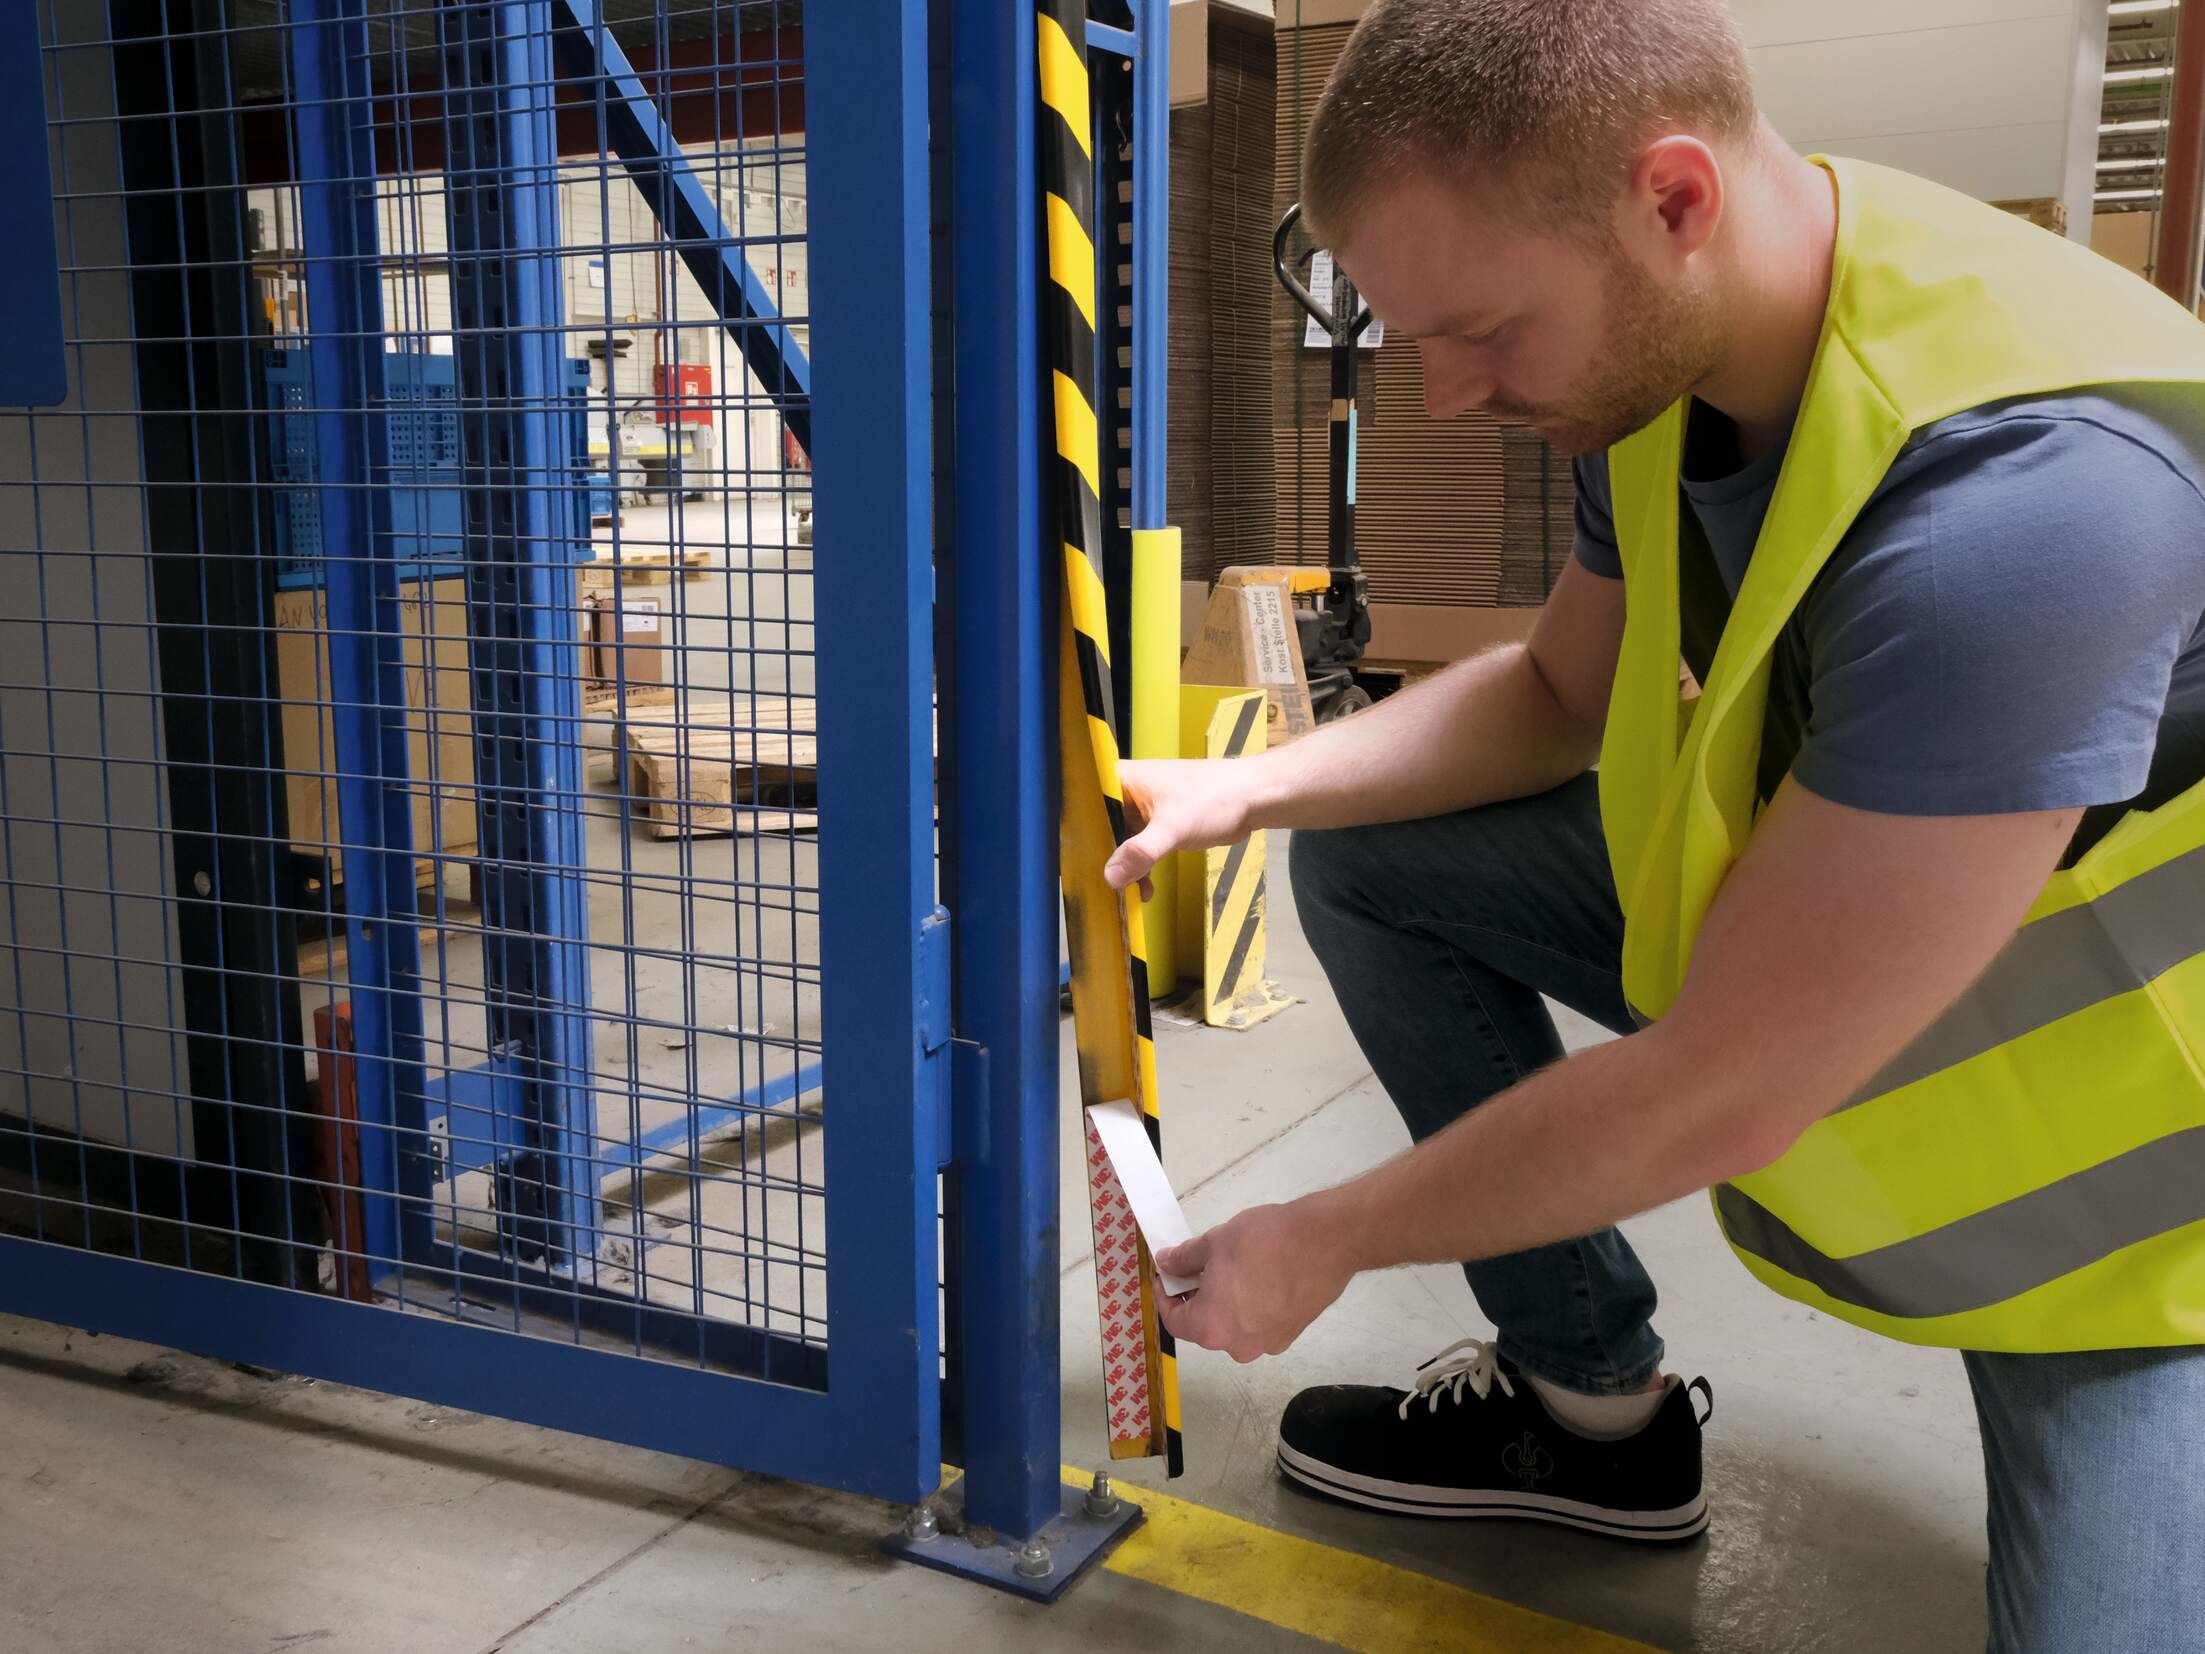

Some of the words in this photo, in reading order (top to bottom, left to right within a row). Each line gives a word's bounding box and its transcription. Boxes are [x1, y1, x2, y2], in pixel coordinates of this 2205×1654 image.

[1253, 591, 1266, 625] Center
[1266, 591, 1279, 615] 2215
[1260, 635, 1272, 673] Service
[1091, 1168, 1111, 1189] 3M
[1093, 1190, 1113, 1212] 3M
[1094, 1212, 1115, 1234] 3M
[1096, 1234, 1116, 1256] 3M
[1097, 1256, 1118, 1278] 3M
[1120, 1254, 1139, 1275] 3M
[1100, 1278, 1120, 1299] 3M
[1122, 1276, 1140, 1297] 3M
[1101, 1300, 1121, 1321] 3M
[1124, 1298, 1142, 1319] 3M
[1103, 1321, 1123, 1343] 3M
[1125, 1319, 1143, 1341] 3M
[1104, 1343, 1125, 1364] 3M
[1127, 1341, 1145, 1362] 3M
[1106, 1365, 1126, 1386] 3M
[1128, 1362, 1146, 1384] 3M
[1108, 1386, 1128, 1407] 3M
[1130, 1384, 1148, 1405] 3M
[1110, 1407, 1130, 1429] 3M
[1131, 1405, 1150, 1426] 3M
